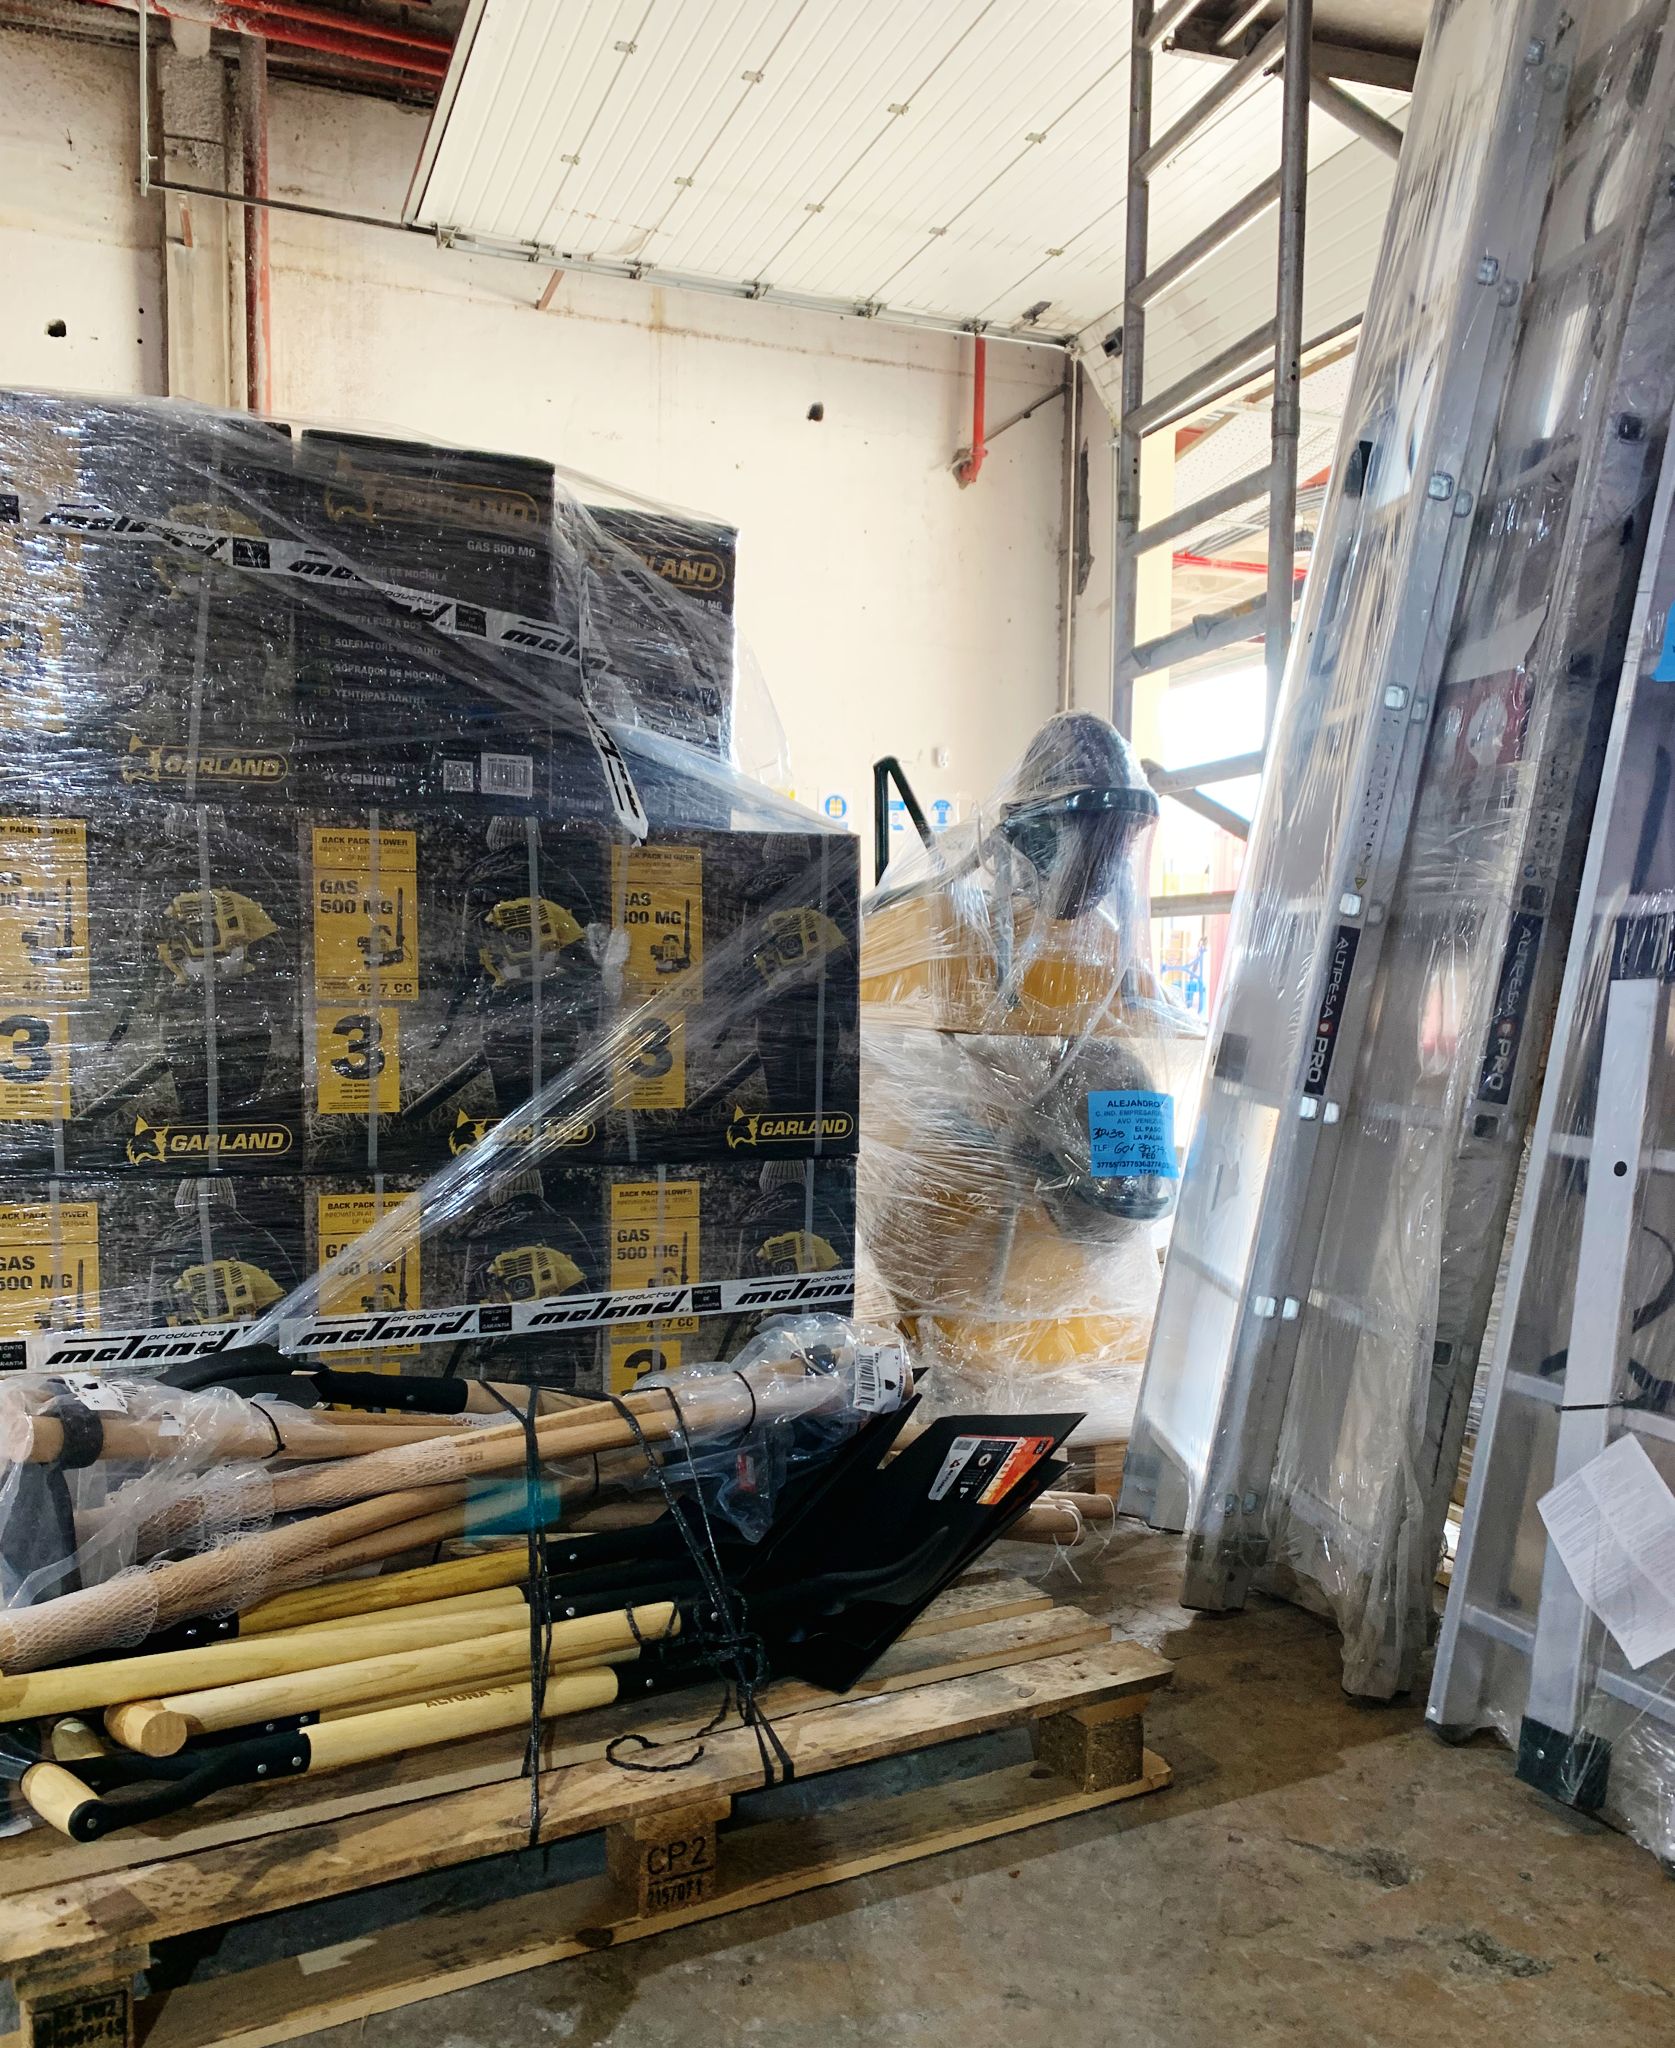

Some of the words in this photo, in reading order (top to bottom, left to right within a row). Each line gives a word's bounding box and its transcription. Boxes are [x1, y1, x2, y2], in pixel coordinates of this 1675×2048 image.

[467, 540, 490, 552] GAS
[494, 543, 515, 556] 500
[321, 836, 345, 844] BACK
[347, 837, 370, 845] PACK
[373, 838, 409, 847] LOWER
[320, 879, 359, 895] GAS
[320, 899, 356, 914] 500
[655, 910, 681, 925] MG
[1320, 936, 1350, 1019] ALTIPESA
[0, 1015, 52, 1083] 3
[330, 1014, 386, 1080] 3
[1307, 1036, 1328, 1084] PRO
[1107, 1099, 1160, 1108] ALEJANDRO
[760, 1119, 848, 1136] GARLAND
[170, 1132, 285, 1152] GARLAND
[619, 1190, 640, 1198] BACK
[353, 1201, 375, 1209] PACK
[23, 1211, 48, 1220] PACK
[617, 1229, 650, 1243] GAS
[617, 1246, 648, 1261] 500
[614, 1290, 679, 1303] productos
[528, 1289, 689, 1326] mcland
[391, 1310, 463, 1323] productos
[677, 1317, 693, 1328] CC
[147, 1329, 226, 1342] productos
[298, 1310, 477, 1347] mcland
[46, 1327, 240, 1365] mcland
[425, 1689, 491, 1708] ALTUNA
[647, 1836, 709, 1875] CP2
